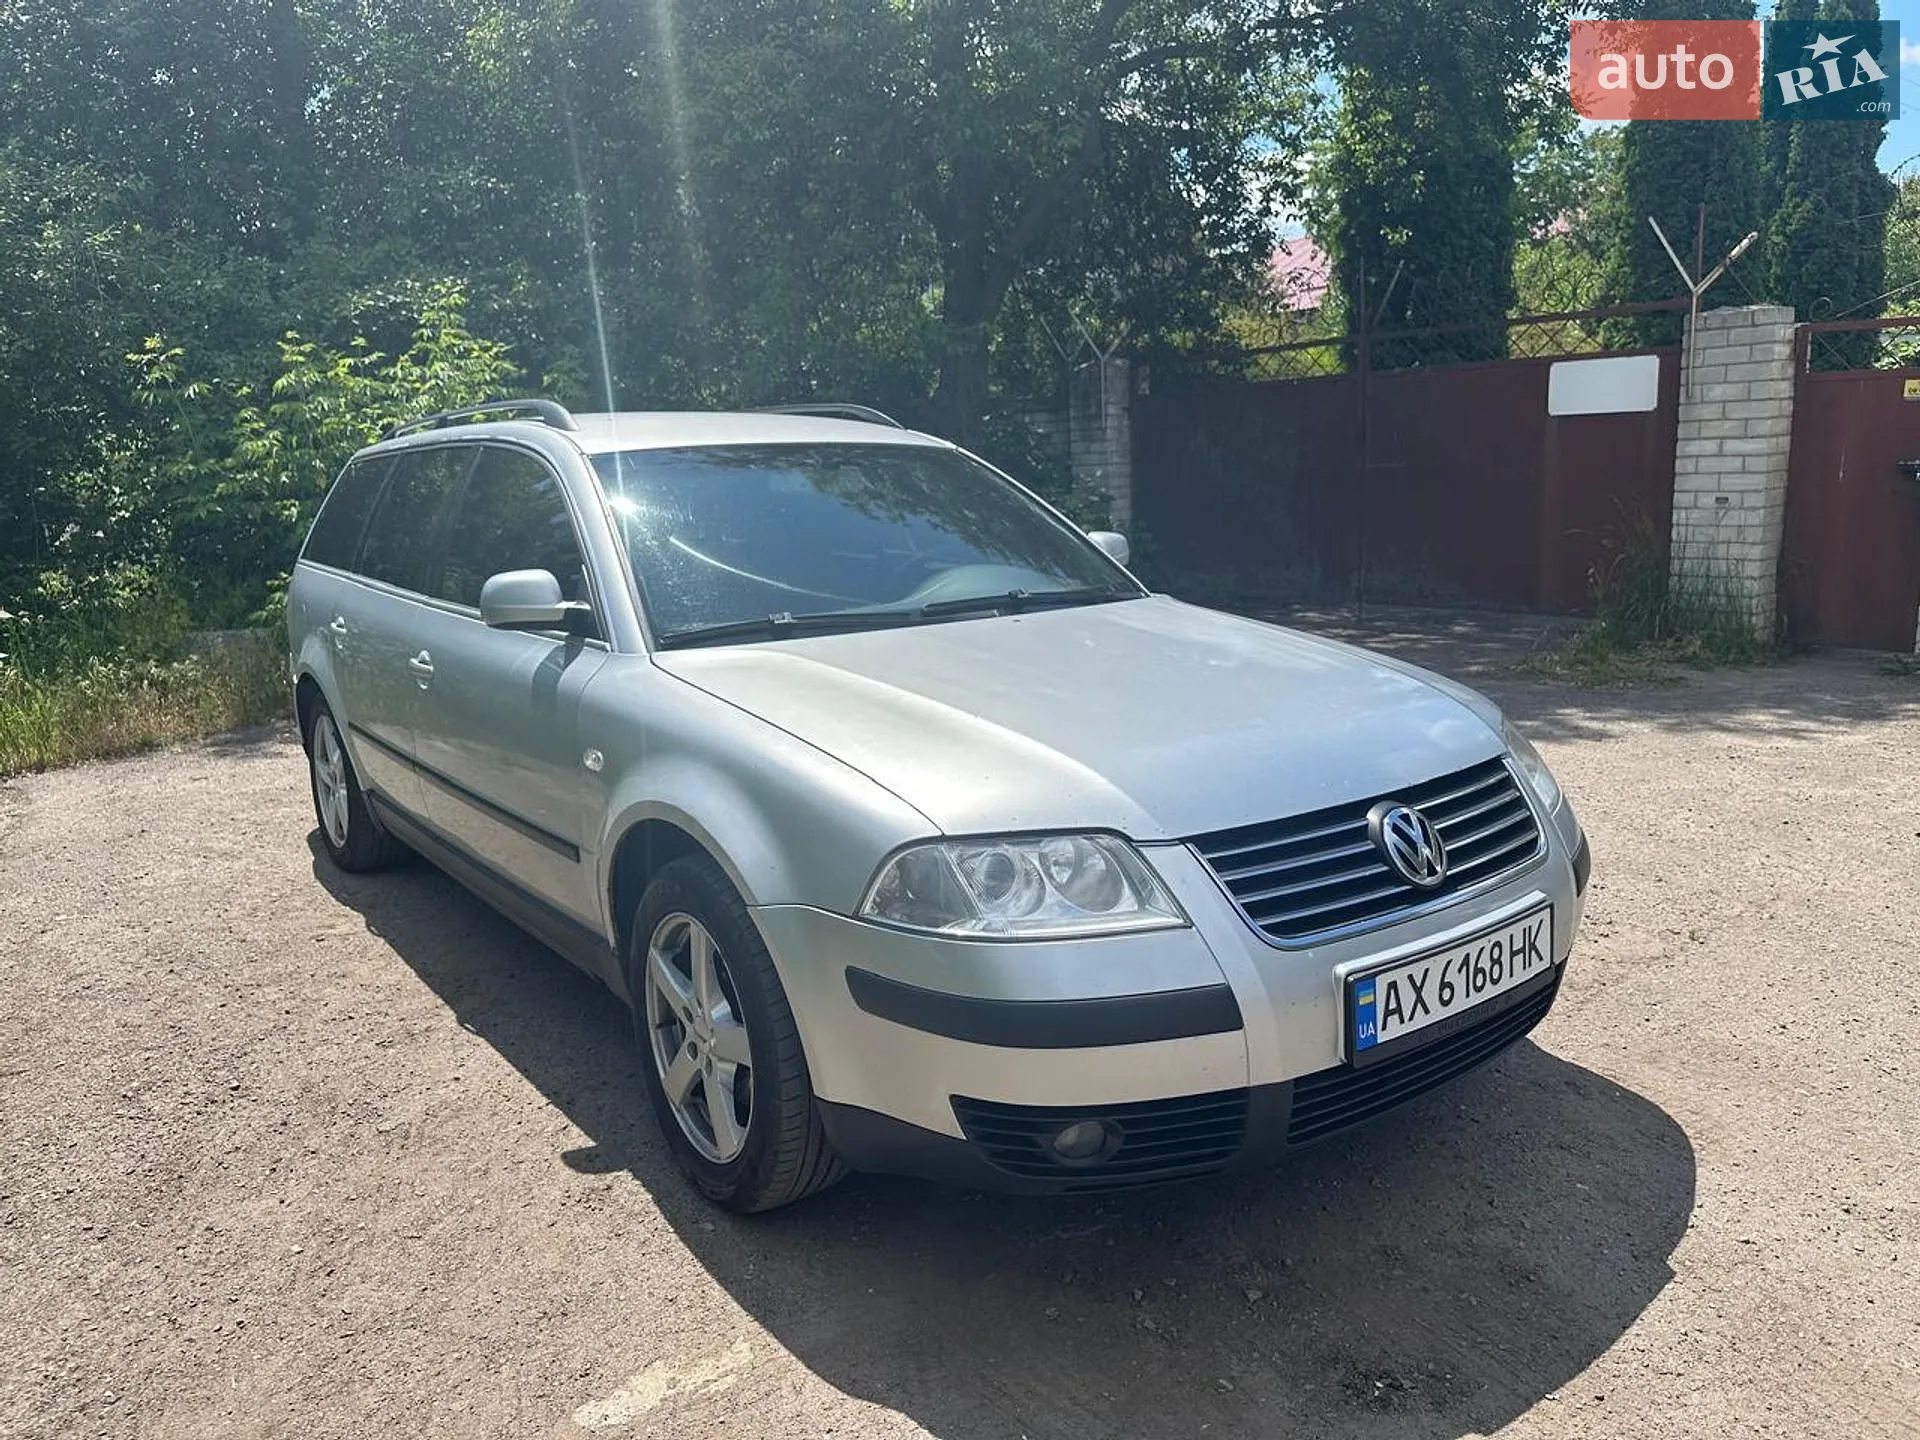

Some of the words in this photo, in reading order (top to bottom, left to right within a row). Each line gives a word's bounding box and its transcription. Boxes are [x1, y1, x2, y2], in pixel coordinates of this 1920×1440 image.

[1381, 967, 1431, 1031] AX
[1438, 941, 1503, 1007] 6168
[1508, 919, 1544, 978] HK
[1358, 1022, 1376, 1039] UA
